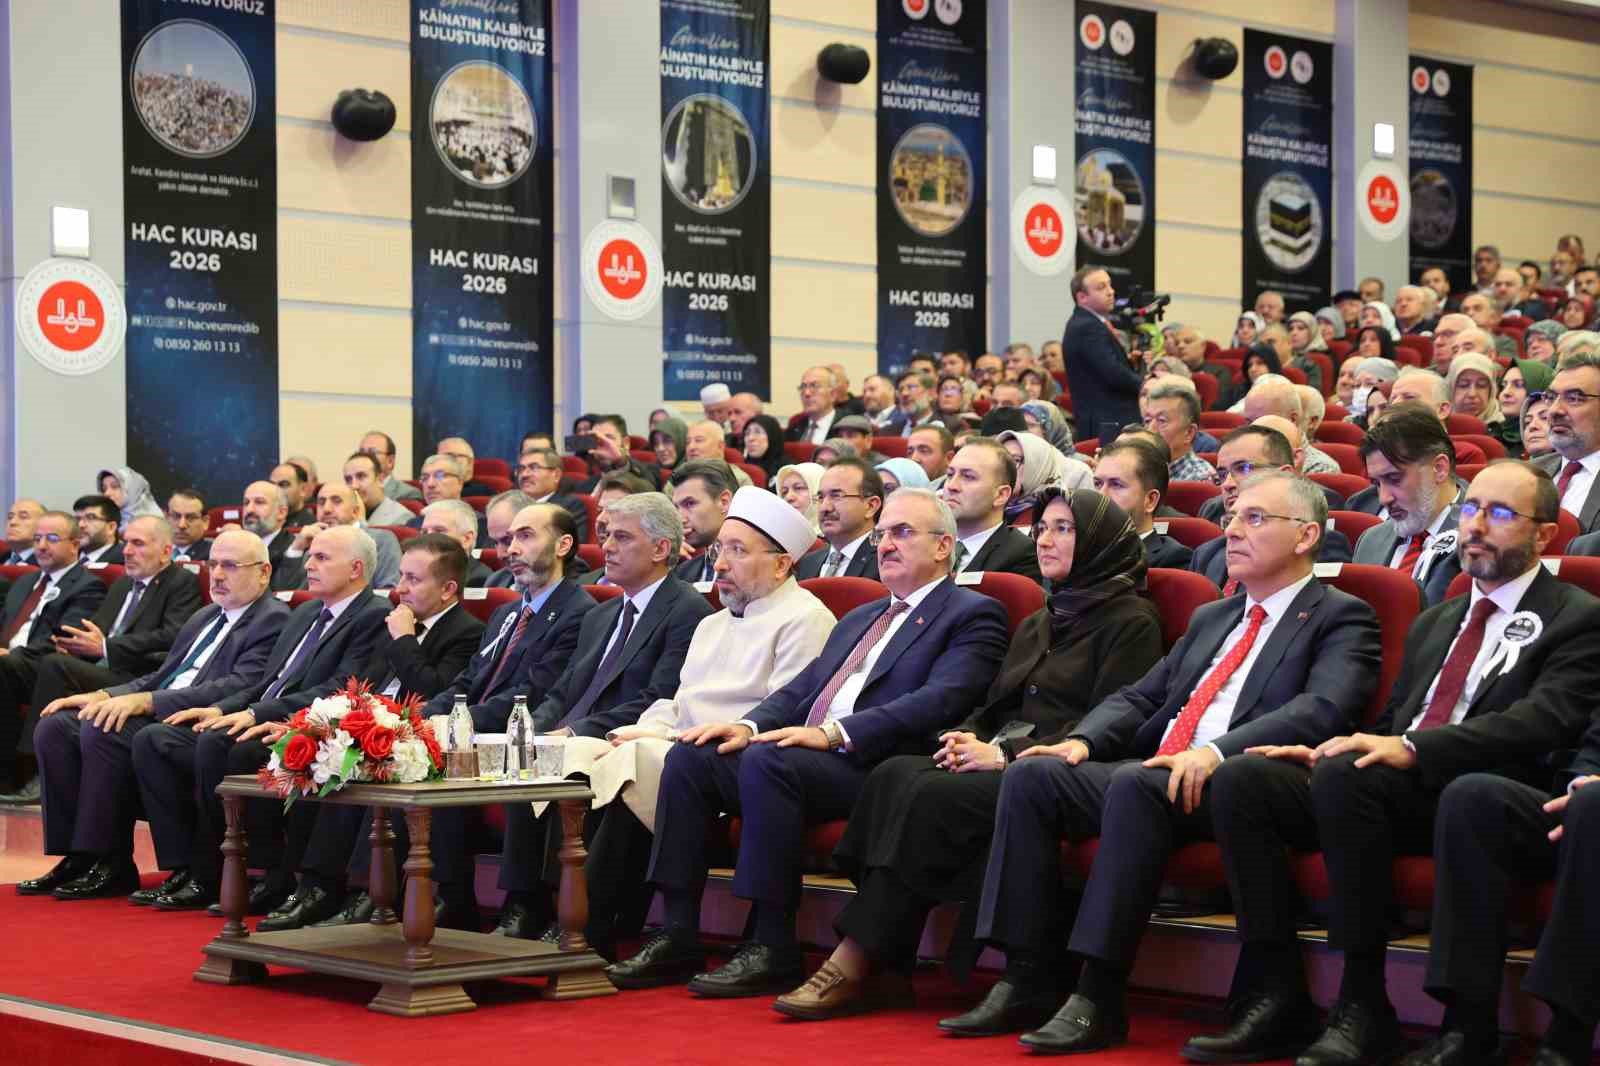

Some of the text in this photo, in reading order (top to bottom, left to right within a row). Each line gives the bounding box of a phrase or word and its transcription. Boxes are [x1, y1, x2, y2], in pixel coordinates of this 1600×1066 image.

[419, 23, 545, 56] BULUŞTURUYORUZ
[660, 62, 764, 88] ULUŞTURUYORUZ
[131, 221, 258, 252] HAC KURASI
[169, 250, 221, 272] 2026
[429, 249, 539, 276] HAC KURASI
[462, 274, 507, 294] 2026
[662, 271, 756, 292] HAC KURASI
[177, 297, 227, 314] hac.gov.tr
[689, 293, 729, 311] 2026
[889, 289, 974, 310] HAC KURASI
[914, 310, 950, 329] 2026
[165, 337, 240, 354] 0850 260 13 13
[500, 356, 510, 369] 13
[512, 357, 523, 370] 13
